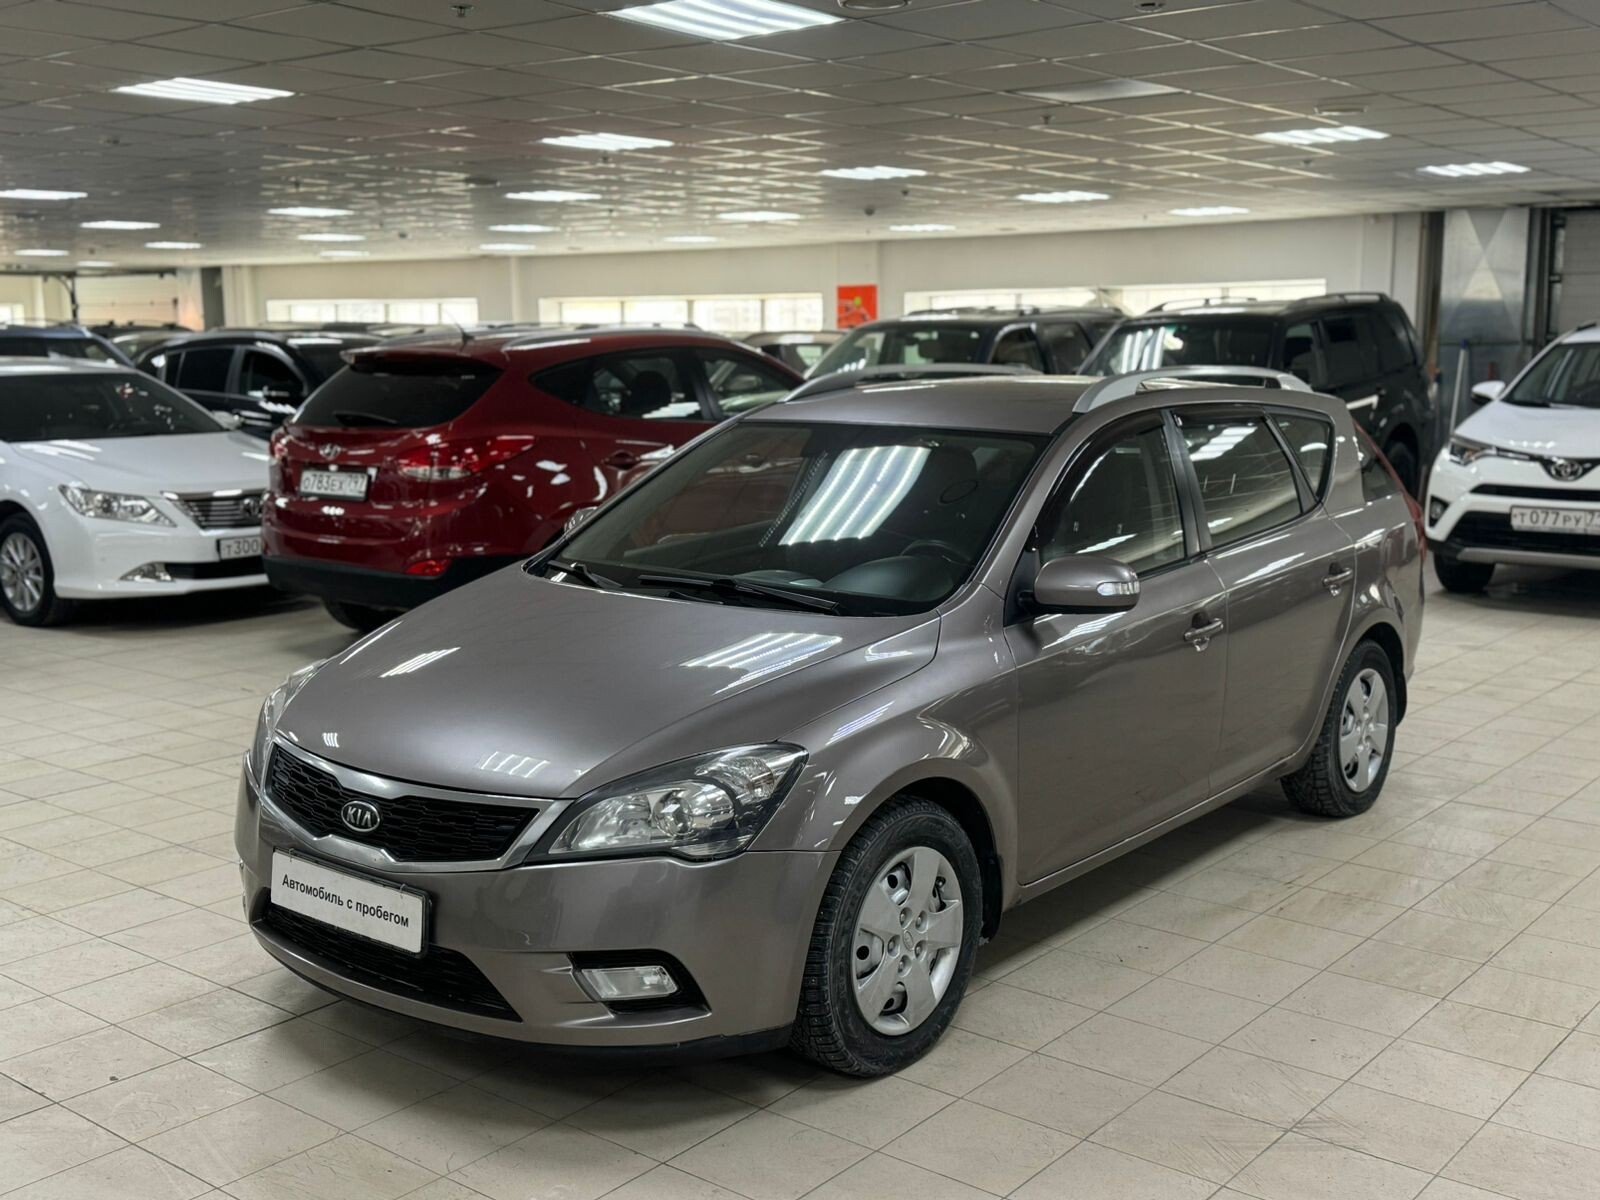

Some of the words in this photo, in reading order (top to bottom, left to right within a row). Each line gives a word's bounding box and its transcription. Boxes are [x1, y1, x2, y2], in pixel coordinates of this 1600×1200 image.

[346, 806, 372, 828] KIA
[282, 874, 344, 906] Автомобиль
[346, 898, 353, 909] с
[355, 901, 409, 928] пробегом
